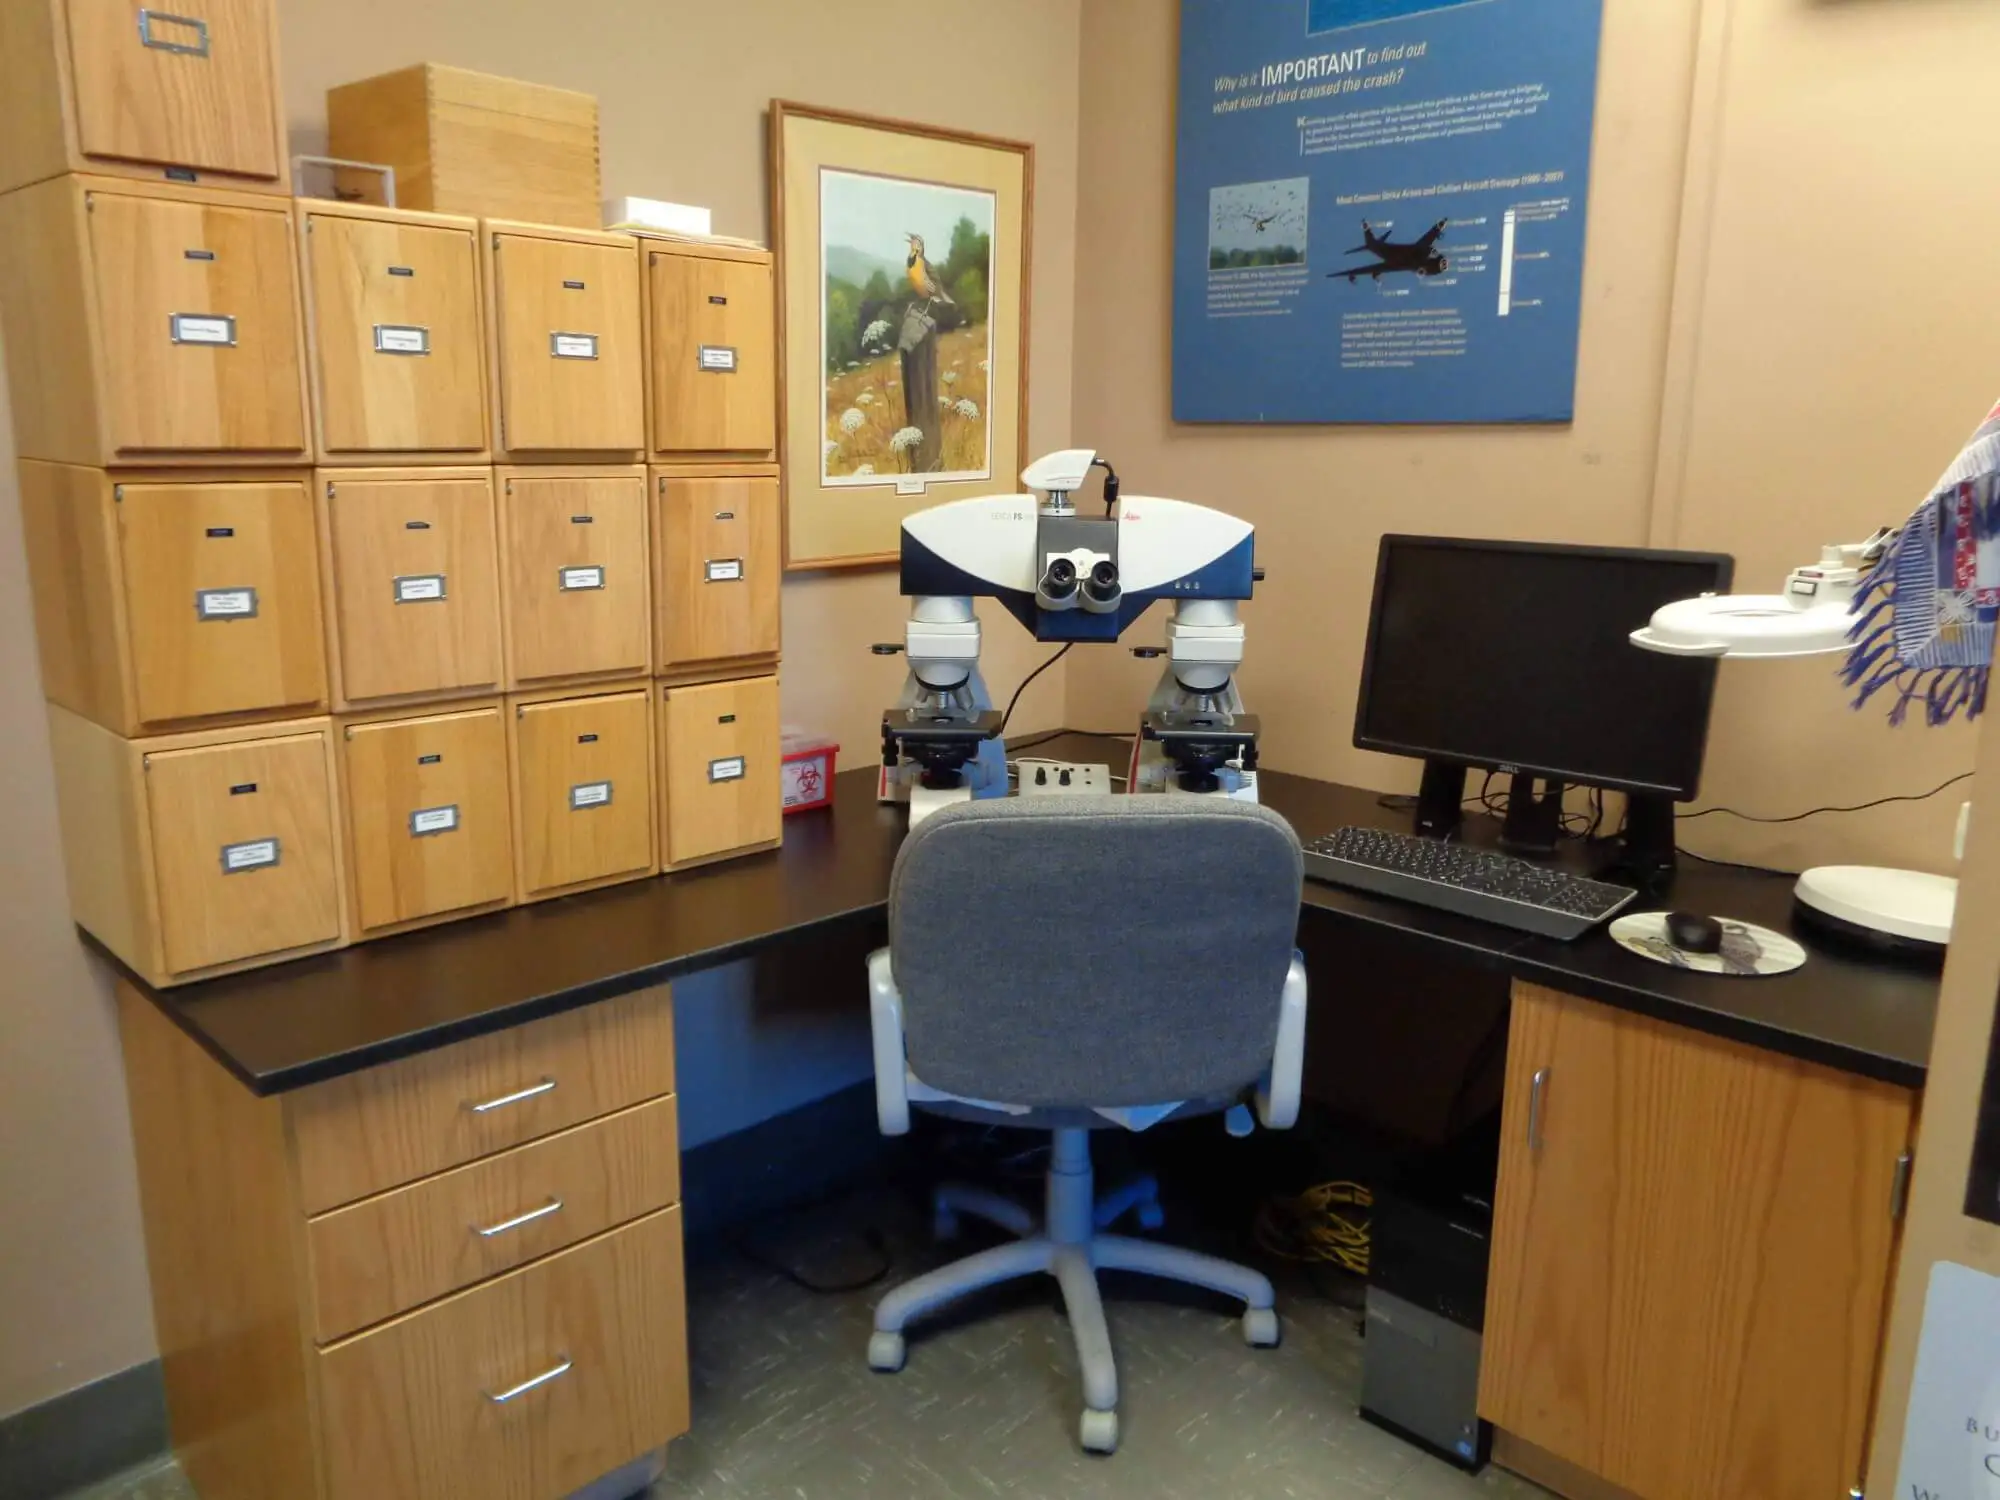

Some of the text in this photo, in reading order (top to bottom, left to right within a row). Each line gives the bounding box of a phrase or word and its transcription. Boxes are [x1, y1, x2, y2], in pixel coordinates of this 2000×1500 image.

[1212, 68, 1404, 114] what kind of bird caused the crash?
[1214, 42, 1427, 93] Why is it IMPORTANT to find out
